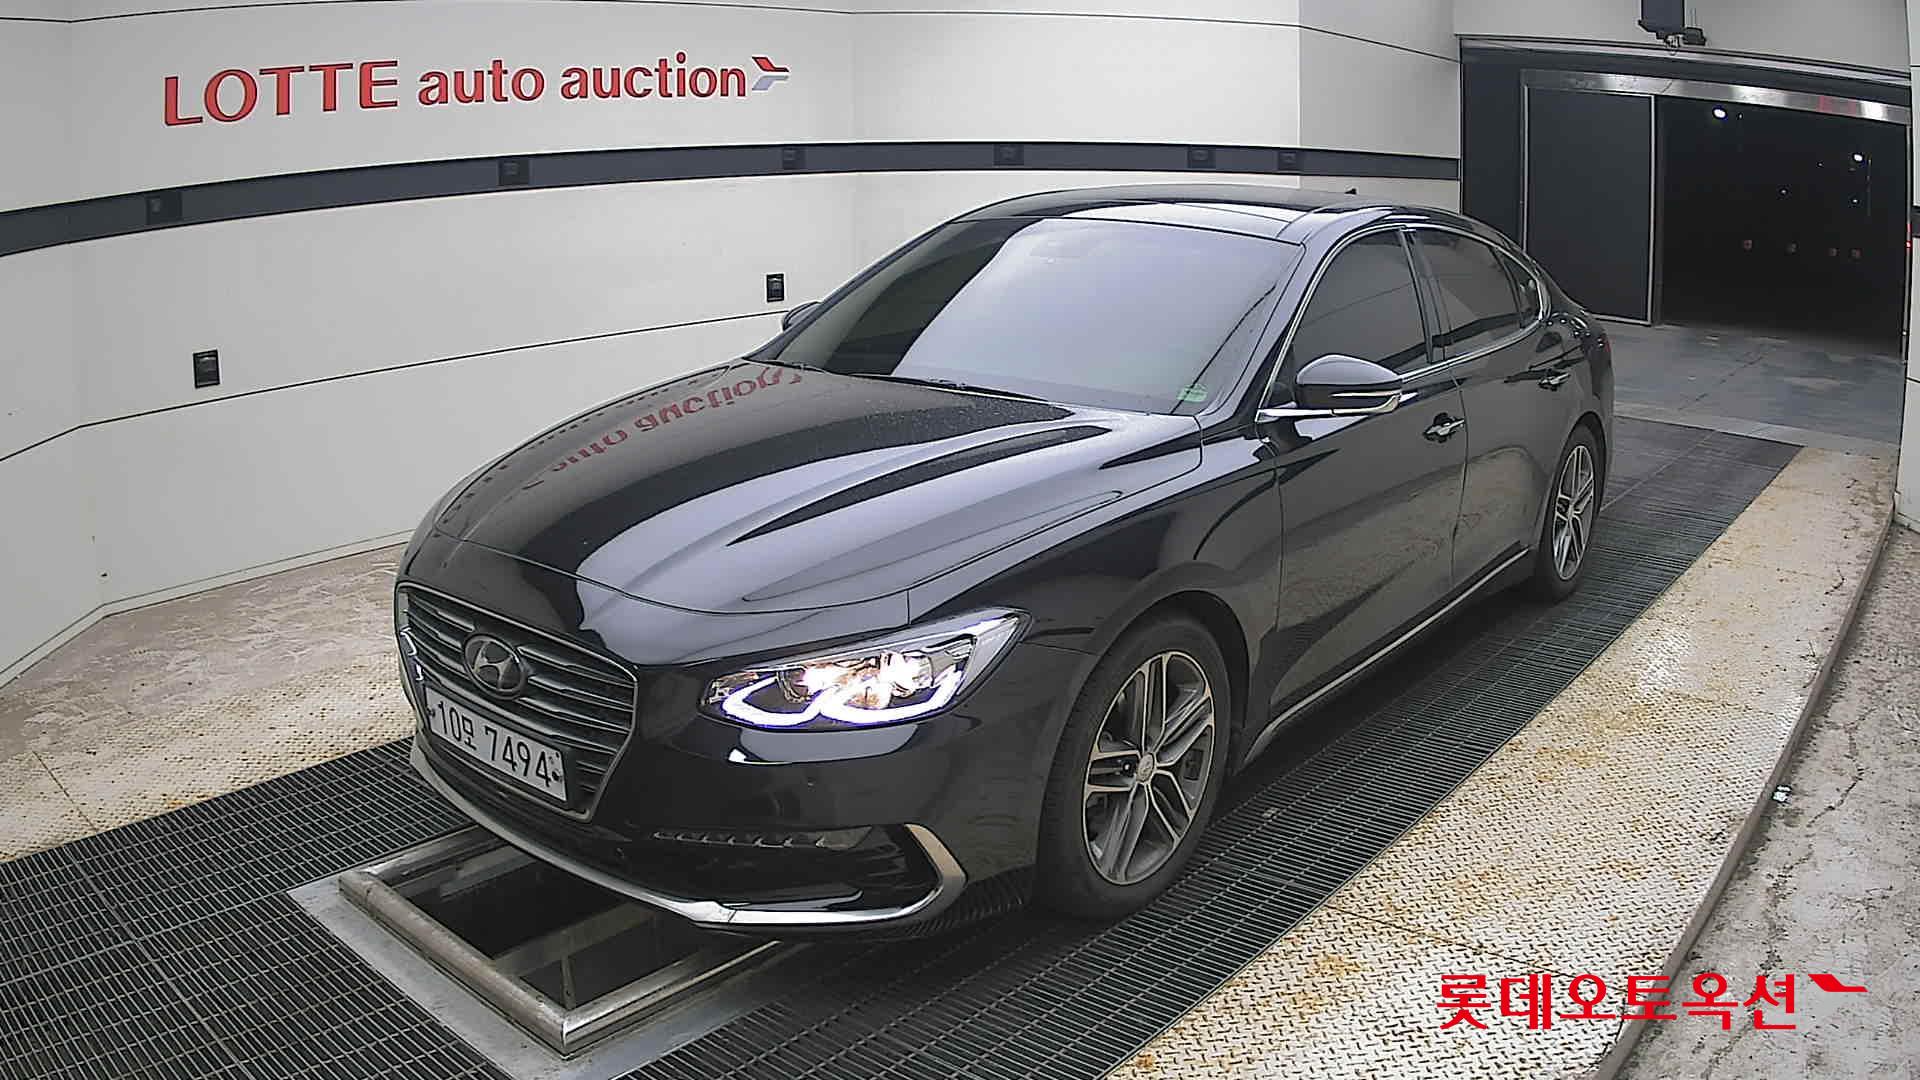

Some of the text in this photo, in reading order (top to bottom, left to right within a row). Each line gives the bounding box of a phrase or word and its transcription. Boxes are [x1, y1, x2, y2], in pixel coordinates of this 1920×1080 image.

[164, 52, 746, 126] LOTTE auto auction
[484, 725, 553, 788] 7494
